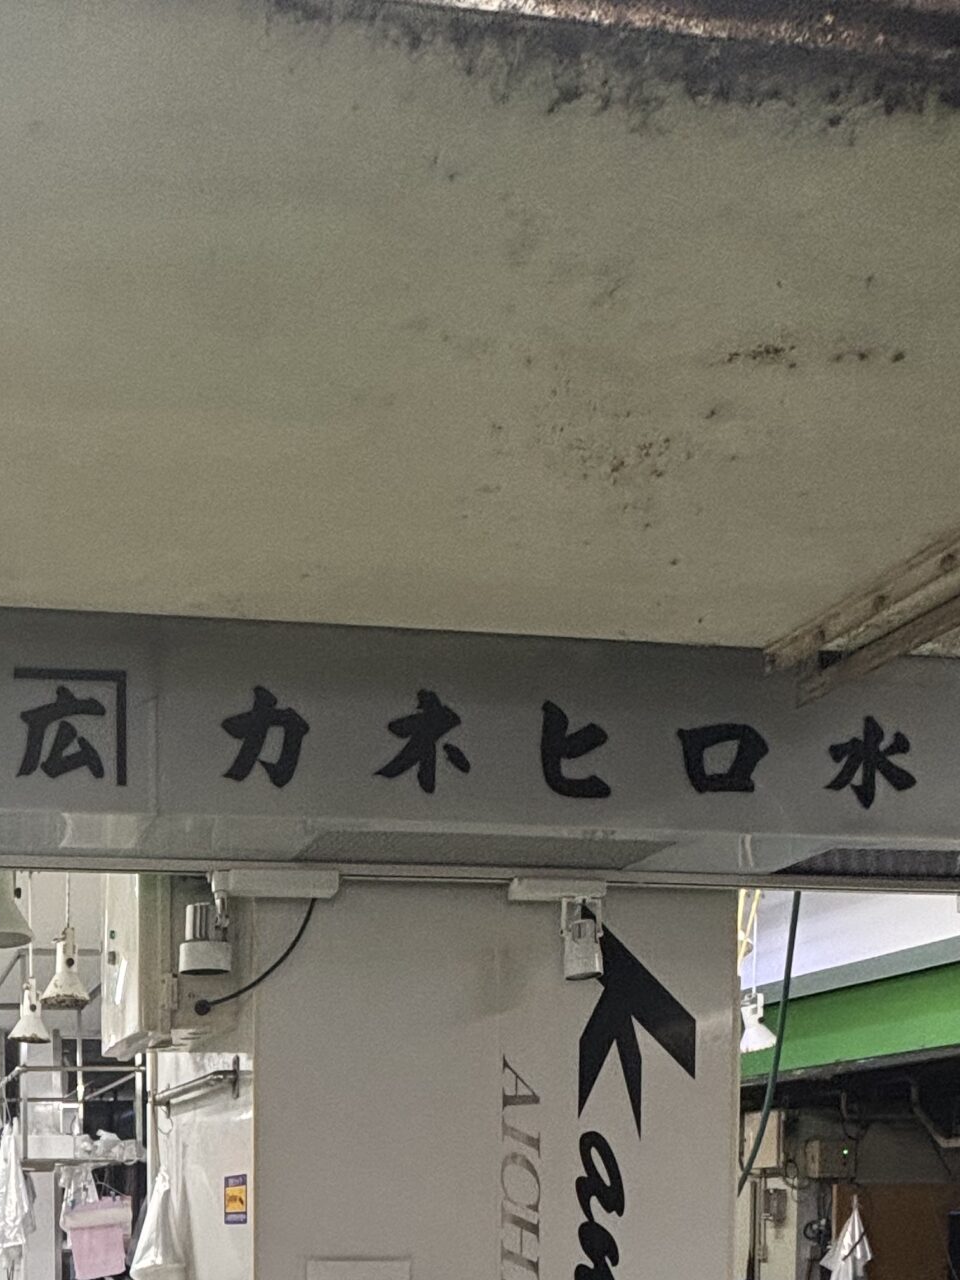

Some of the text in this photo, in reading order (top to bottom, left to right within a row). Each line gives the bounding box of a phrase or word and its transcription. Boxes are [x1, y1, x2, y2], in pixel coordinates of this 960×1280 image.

[223, 685, 917, 809] カネヒロ水
